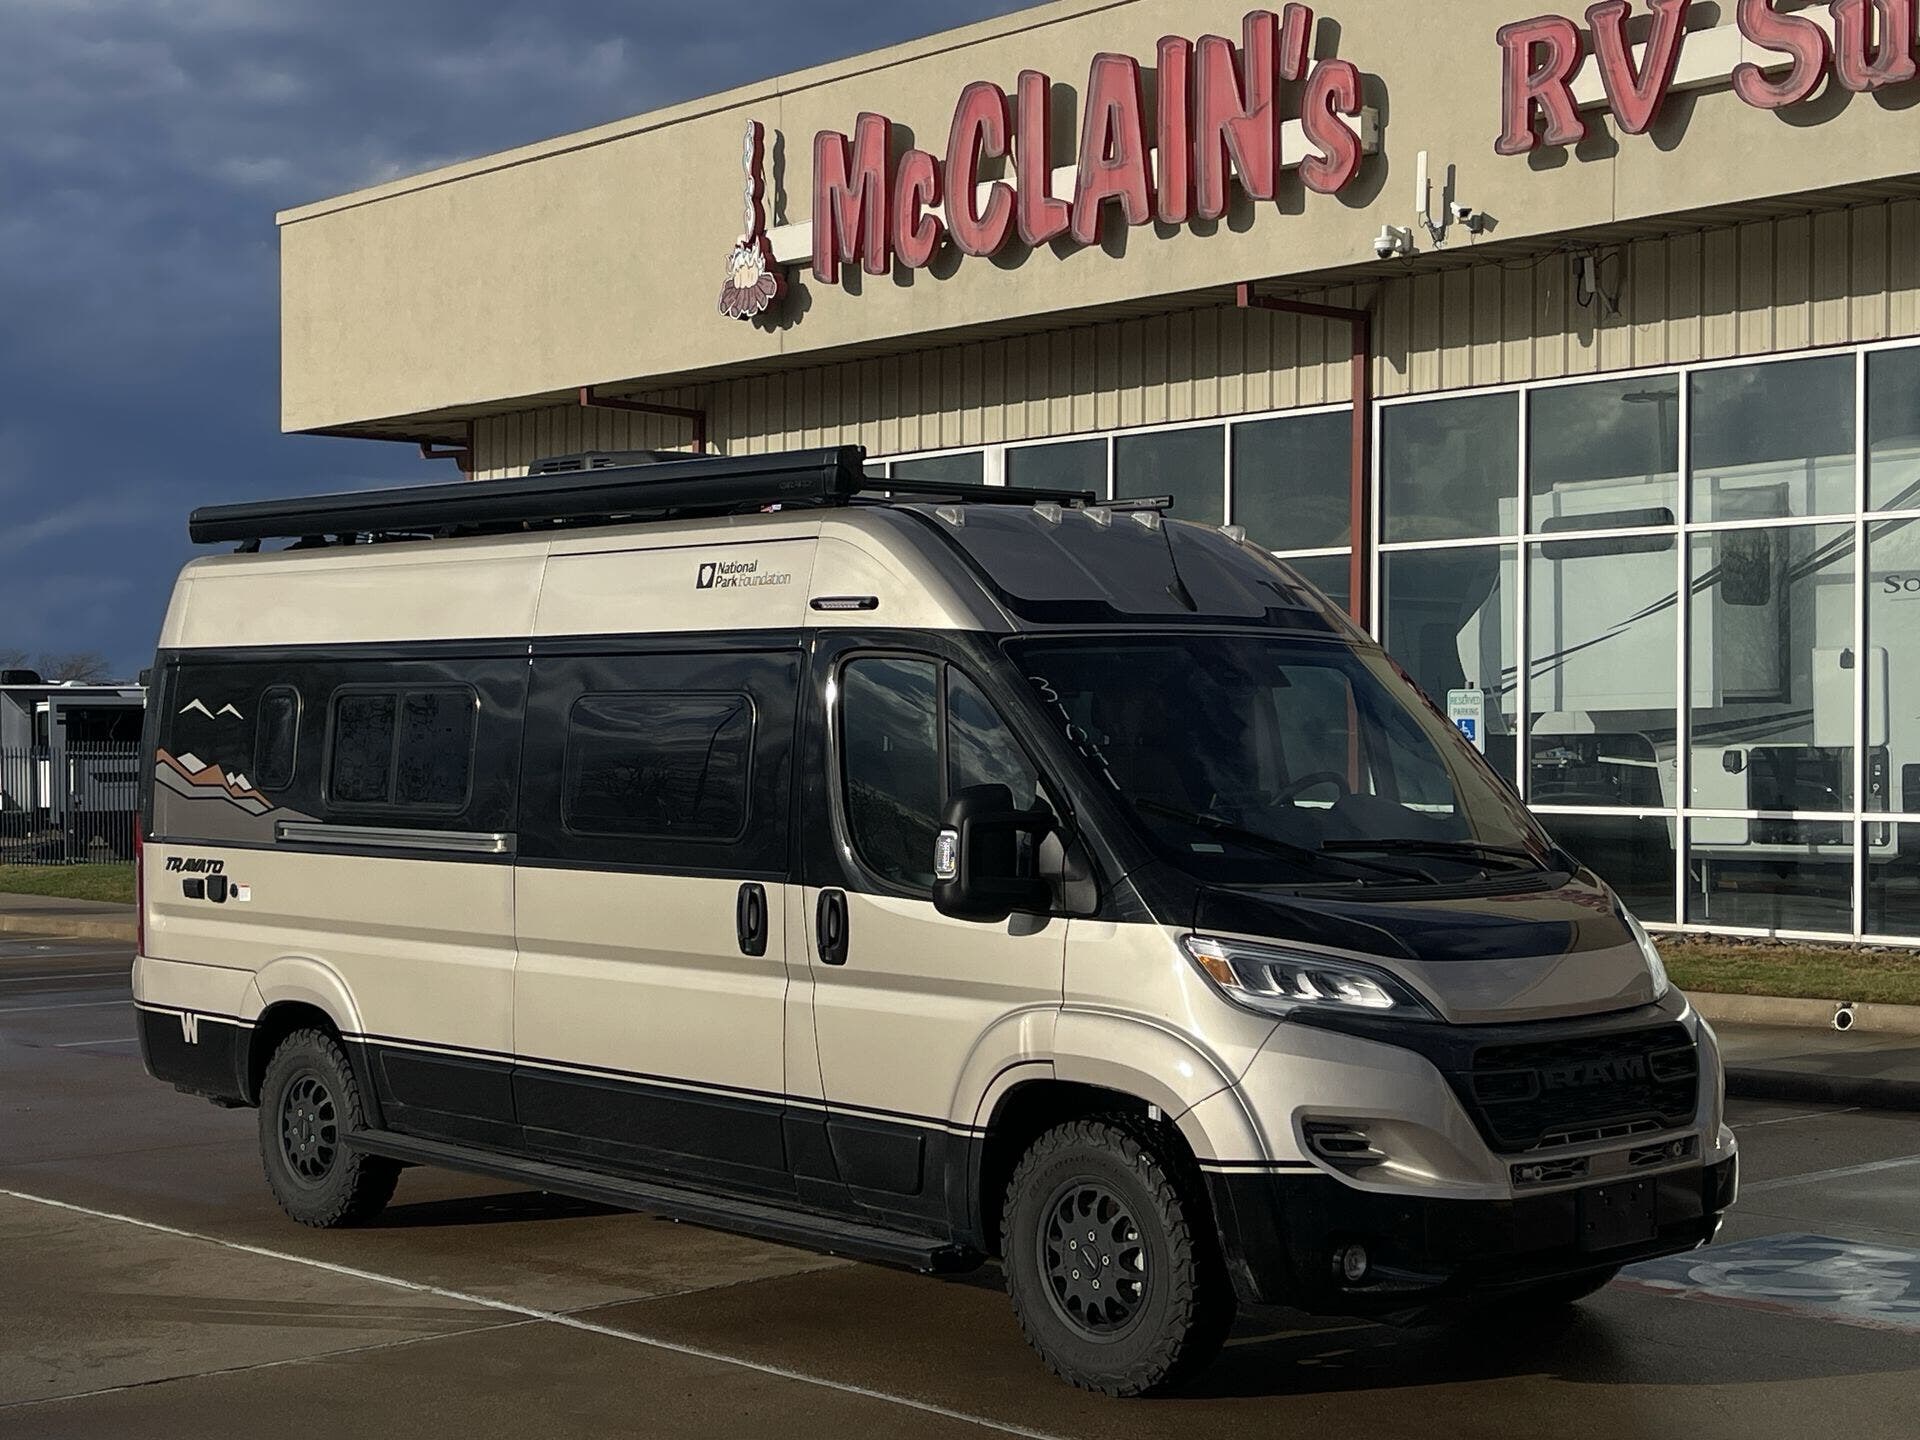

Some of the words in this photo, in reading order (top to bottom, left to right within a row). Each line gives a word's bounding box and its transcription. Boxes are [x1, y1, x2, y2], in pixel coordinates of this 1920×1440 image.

[1495, 0, 1690, 156] RV
[717, 560, 758, 574] National
[715, 574, 738, 588] Park
[738, 571, 791, 587] Foundation
[1449, 696, 1481, 705] RESERVED
[1453, 707, 1480, 716] PARKING
[165, 856, 225, 873] TRAVATO
[1546, 1055, 1645, 1089] RAM
